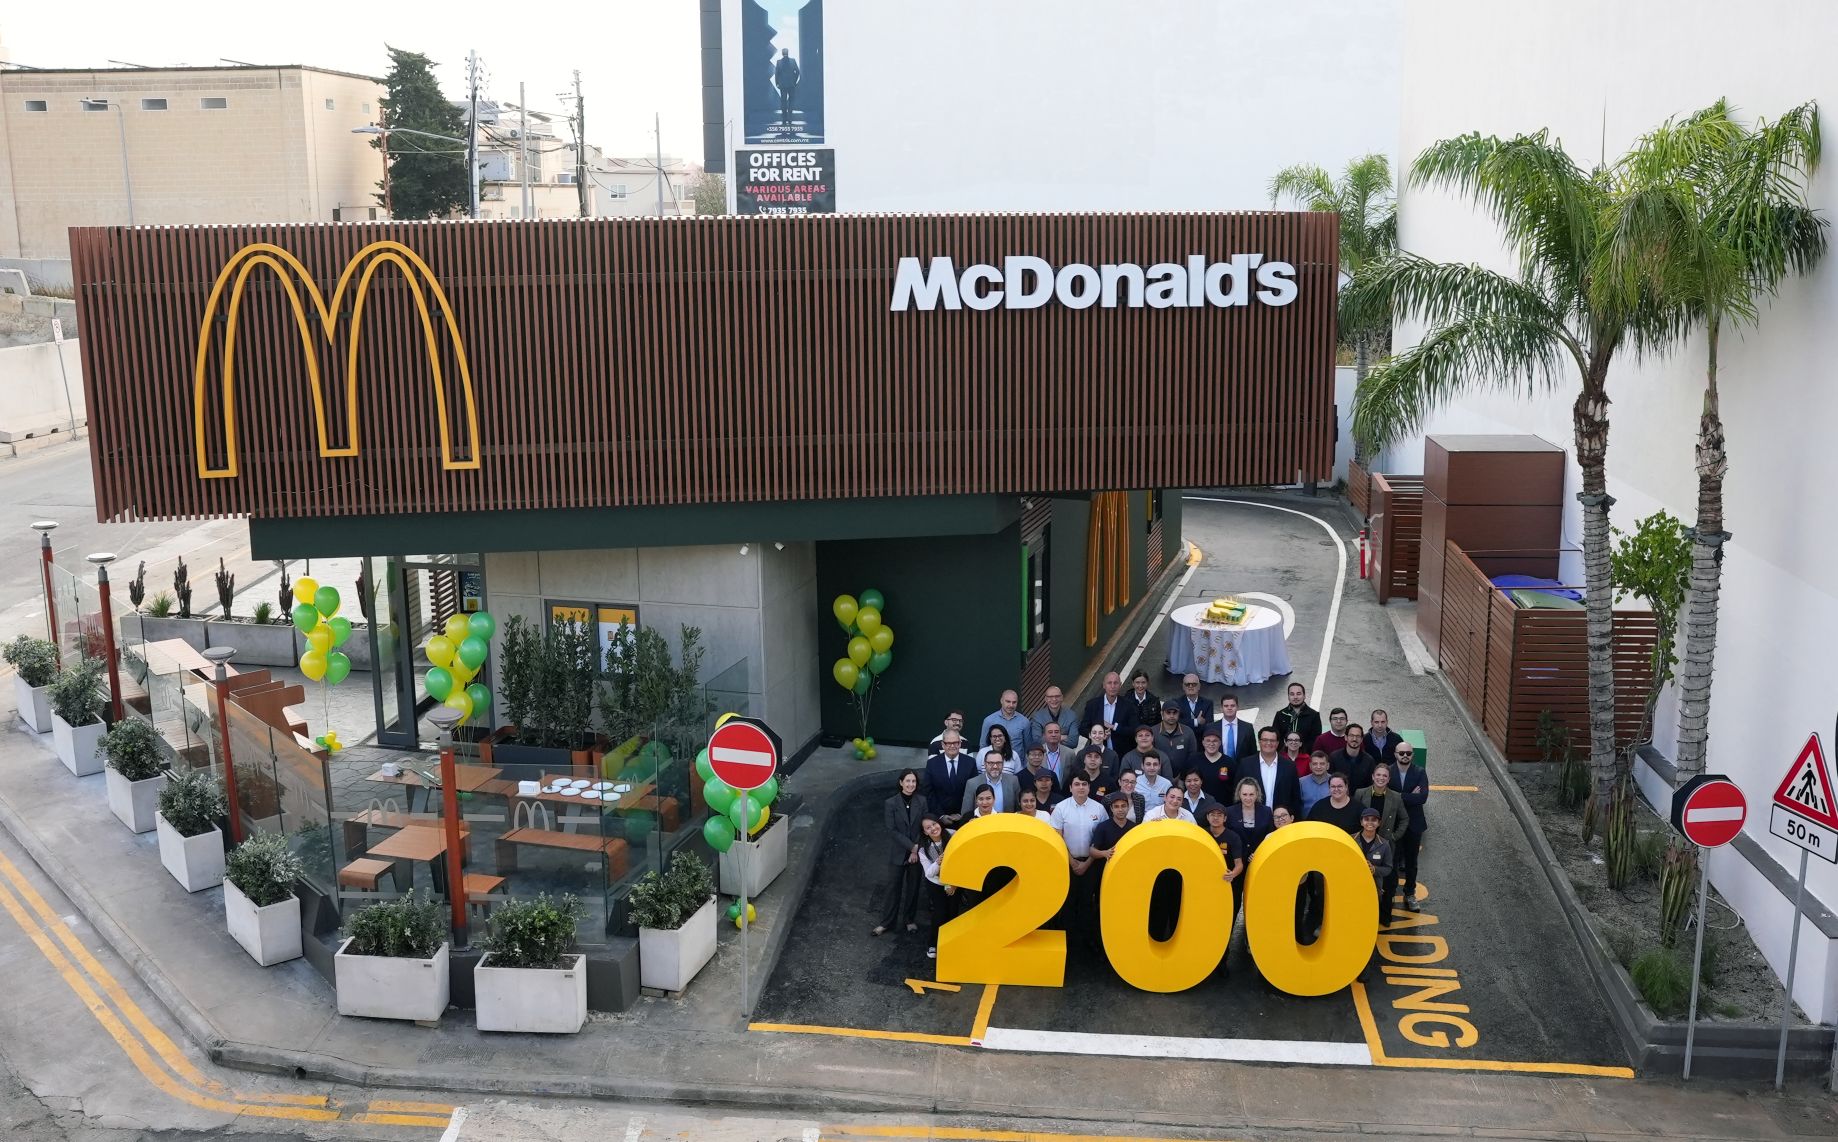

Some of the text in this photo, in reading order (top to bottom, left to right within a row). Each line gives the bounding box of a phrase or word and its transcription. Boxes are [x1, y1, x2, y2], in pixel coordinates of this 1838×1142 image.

[750, 152, 816, 166] OFFICES
[750, 167, 823, 182] FOR RENT
[745, 184, 826, 194] VARIOUS AREAS
[756, 193, 813, 202] AVAILABLE
[788, 206, 807, 214] 7935
[890, 253, 1299, 312] McDonald's
[1787, 819, 1820, 848] 50 m
[935, 813, 1380, 997] 200
[1376, 878, 1479, 1049] ADING
